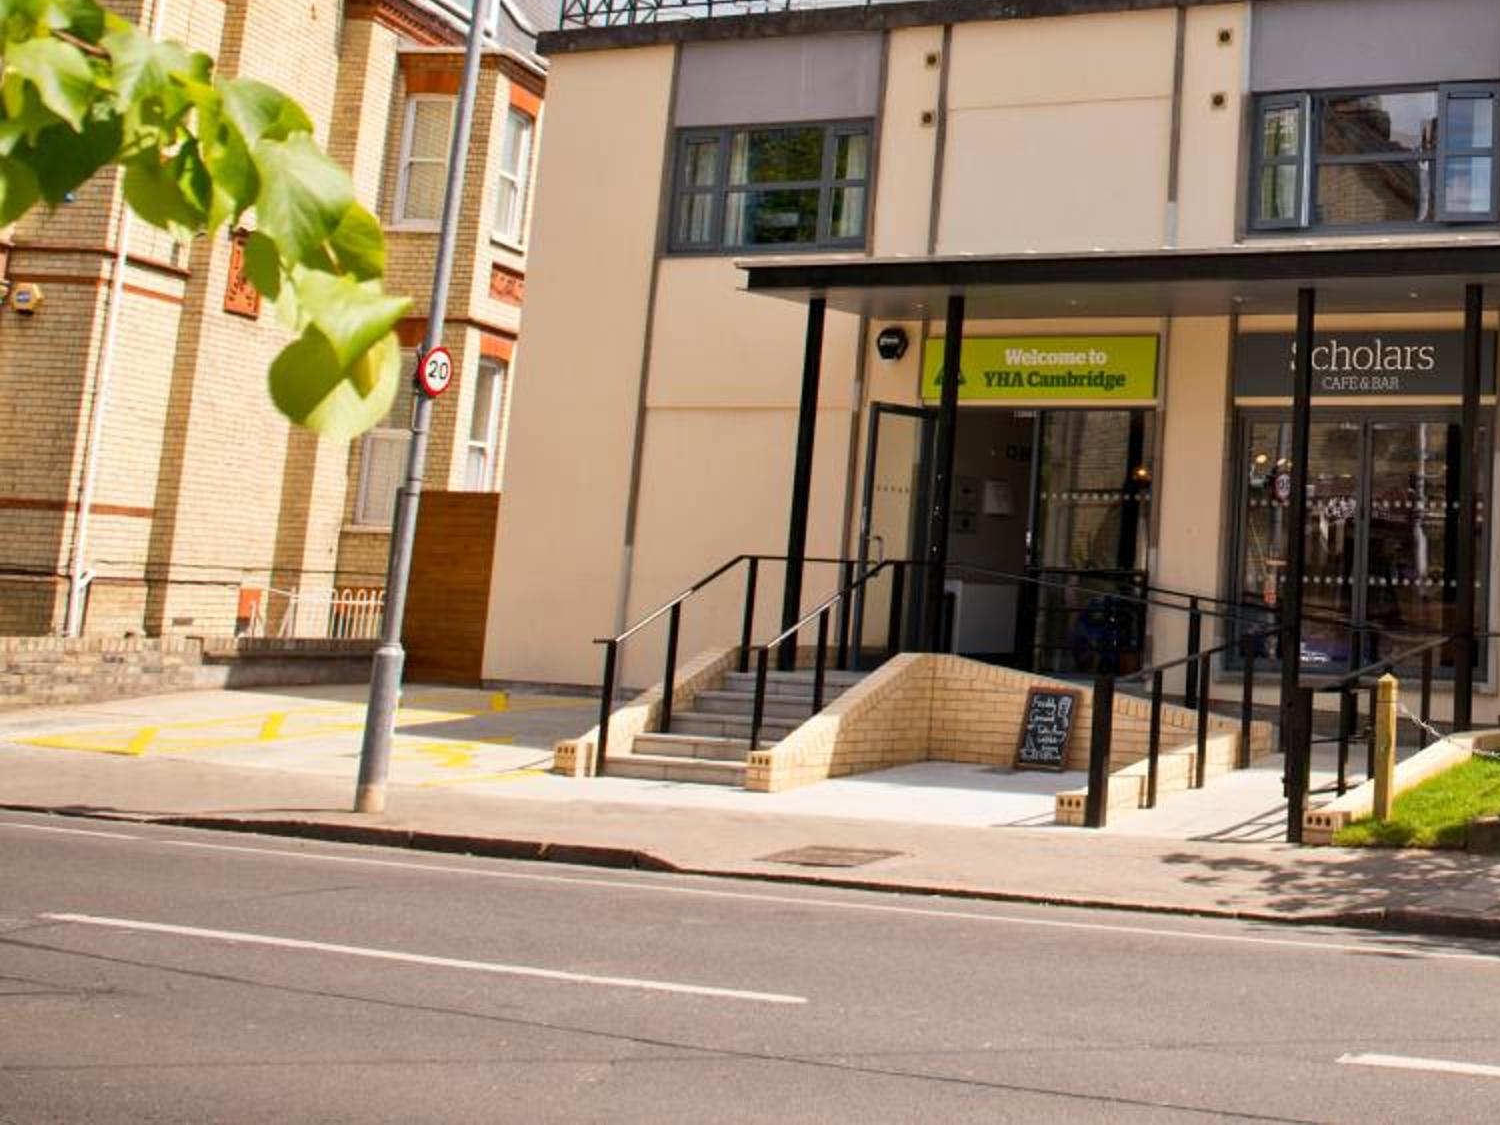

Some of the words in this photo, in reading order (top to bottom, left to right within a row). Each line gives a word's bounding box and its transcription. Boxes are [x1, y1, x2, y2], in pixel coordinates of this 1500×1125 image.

[1005, 348, 1087, 365] Welcome
[1088, 349, 1107, 365] to
[428, 360, 449, 380] 20
[983, 371, 1024, 387] YHA
[1027, 371, 1127, 390] Cambridge
[1360, 376, 1370, 390] &
[1371, 376, 1399, 390] BAR
